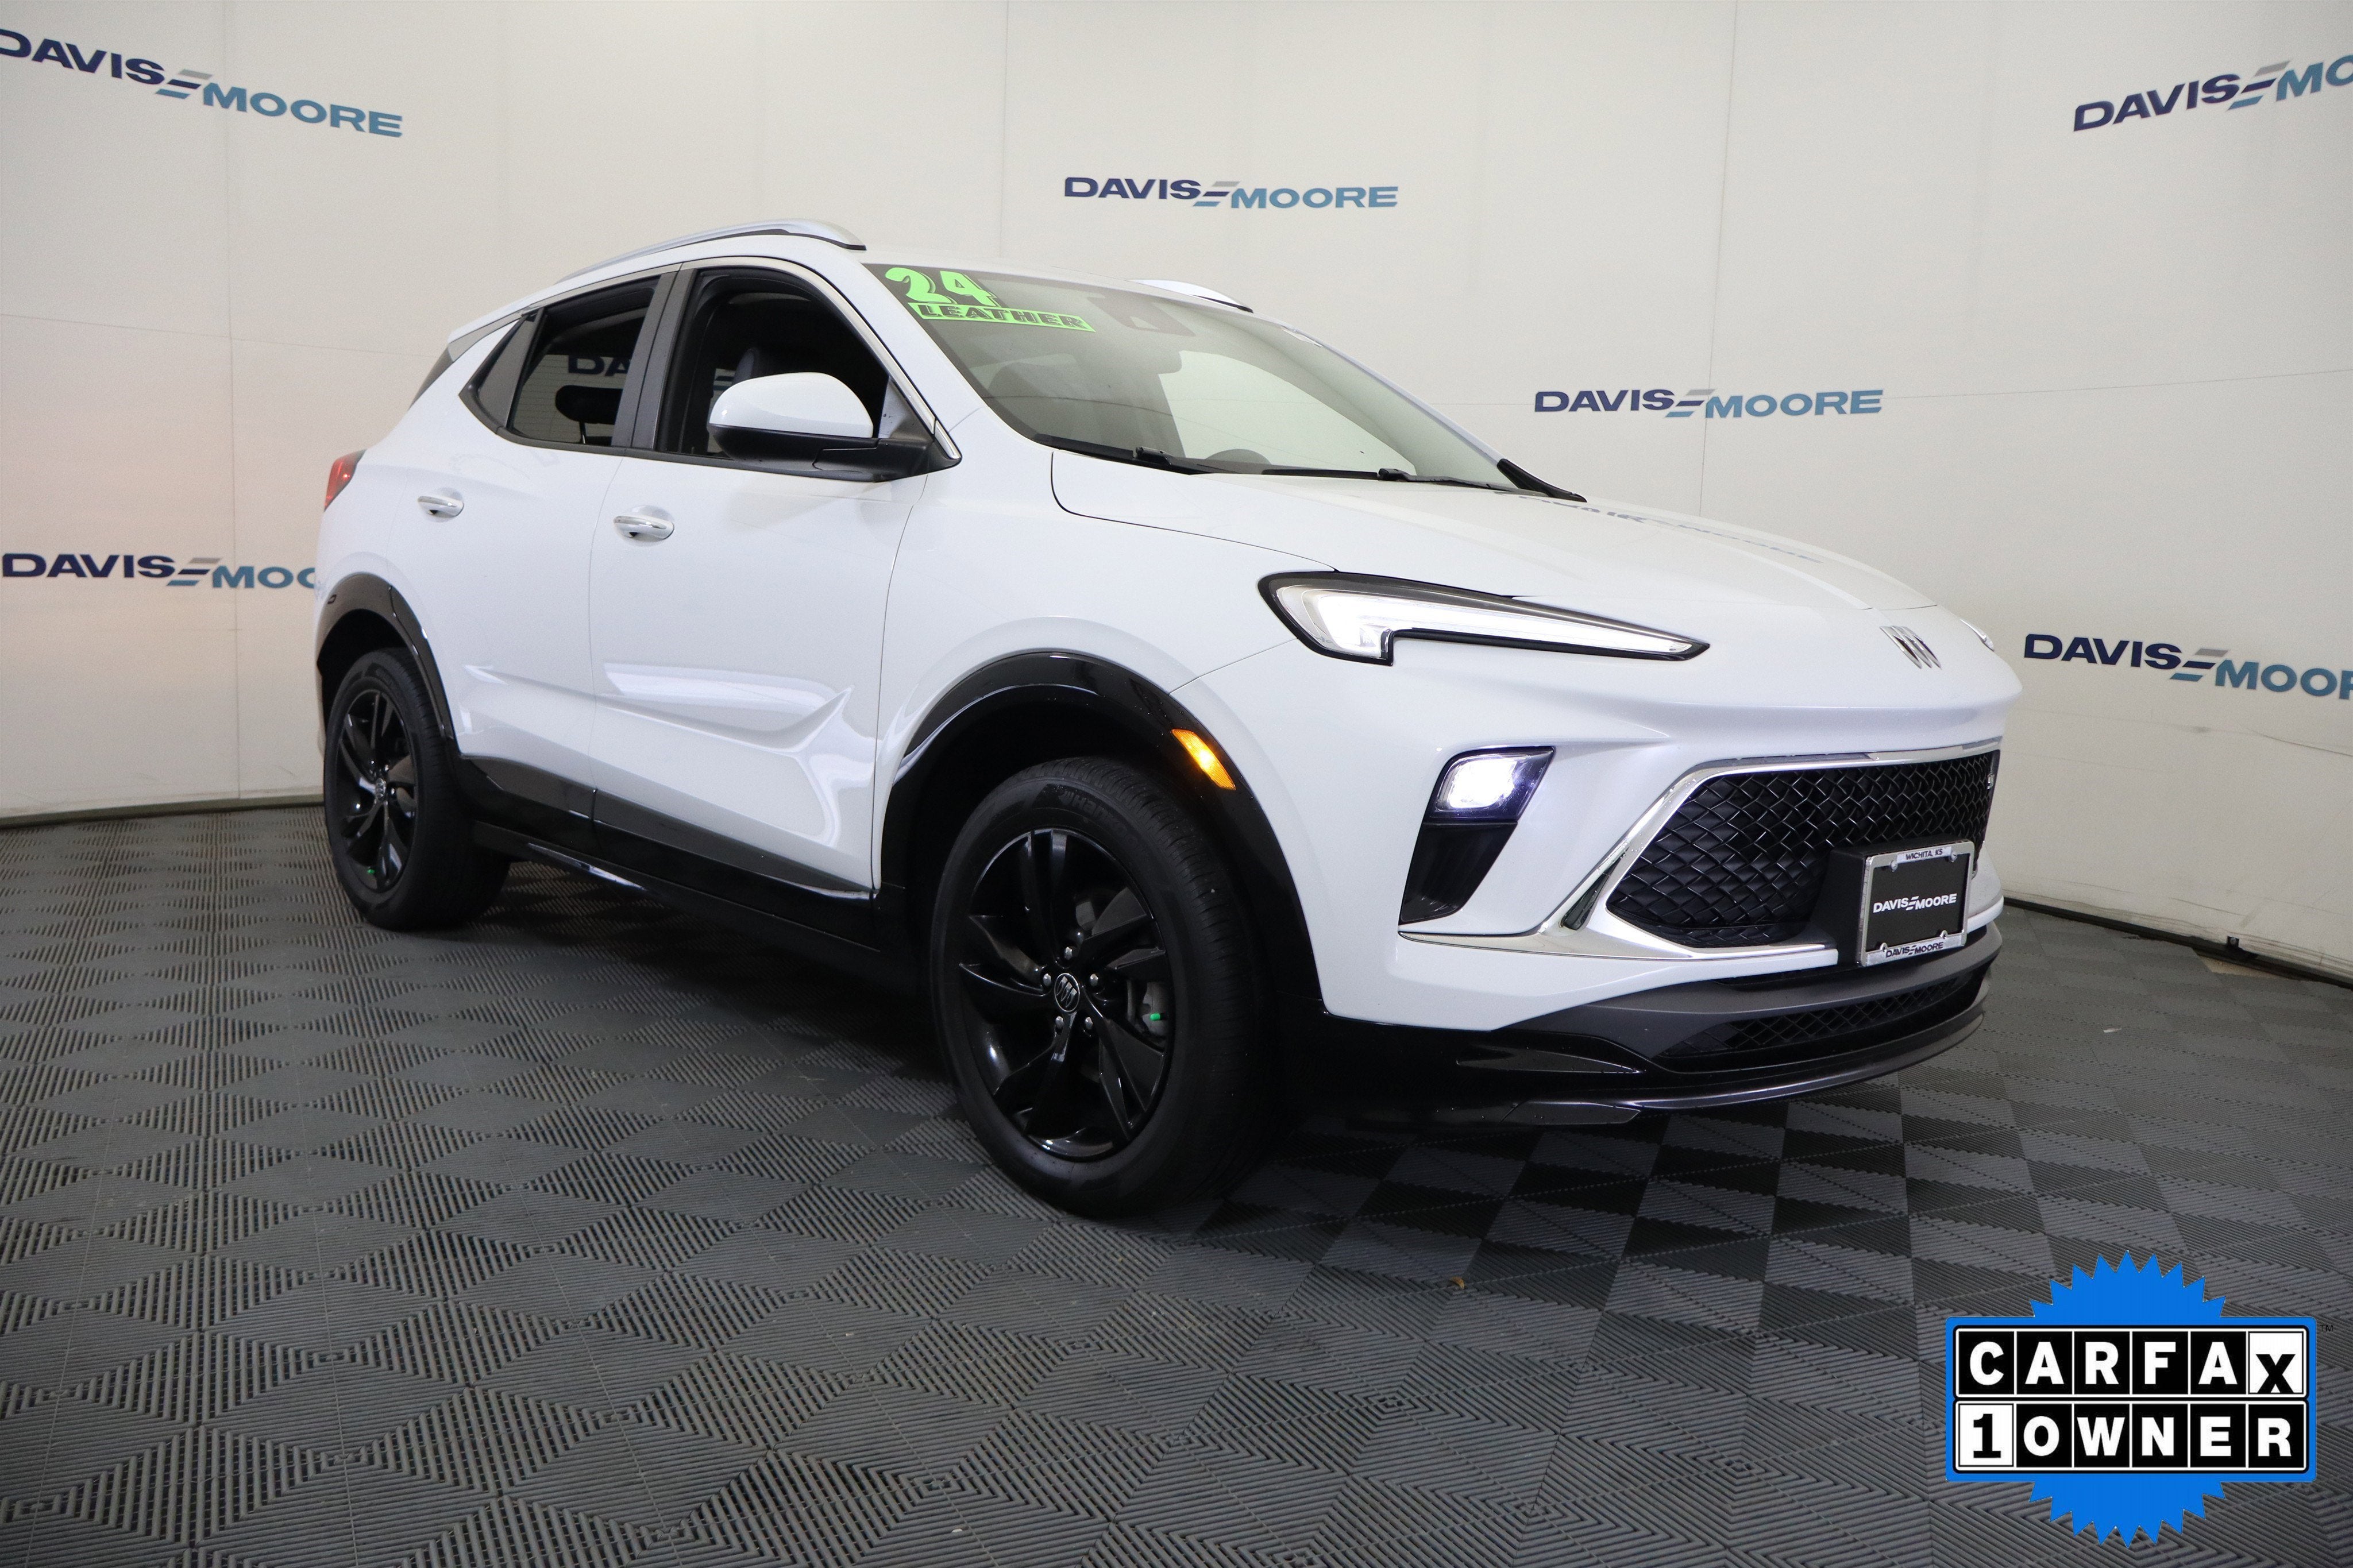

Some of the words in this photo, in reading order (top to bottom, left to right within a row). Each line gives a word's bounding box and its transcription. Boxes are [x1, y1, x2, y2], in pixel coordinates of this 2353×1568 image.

[0, 28, 165, 85] DAVIS
[203, 82, 403, 138] MOORE
[2073, 74, 2241, 132] DAVIS
[1064, 176, 1202, 200] DAVIS
[1230, 186, 1399, 209] MOORE
[885, 267, 997, 307] 24
[917, 304, 1089, 329] LEATHER
[1534, 388, 1676, 413] DAVIS
[1704, 389, 1884, 419] MOORE
[2, 553, 176, 578] DAVIS
[2024, 633, 2183, 670] DAVIS
[1935, 848, 1943, 856] KS
[1873, 897, 1910, 913] DAVIS
[1915, 893, 1957, 910] MOORE
[1885, 946, 1910, 958] DAVIS
[1914, 942, 1944, 955] MOORE
